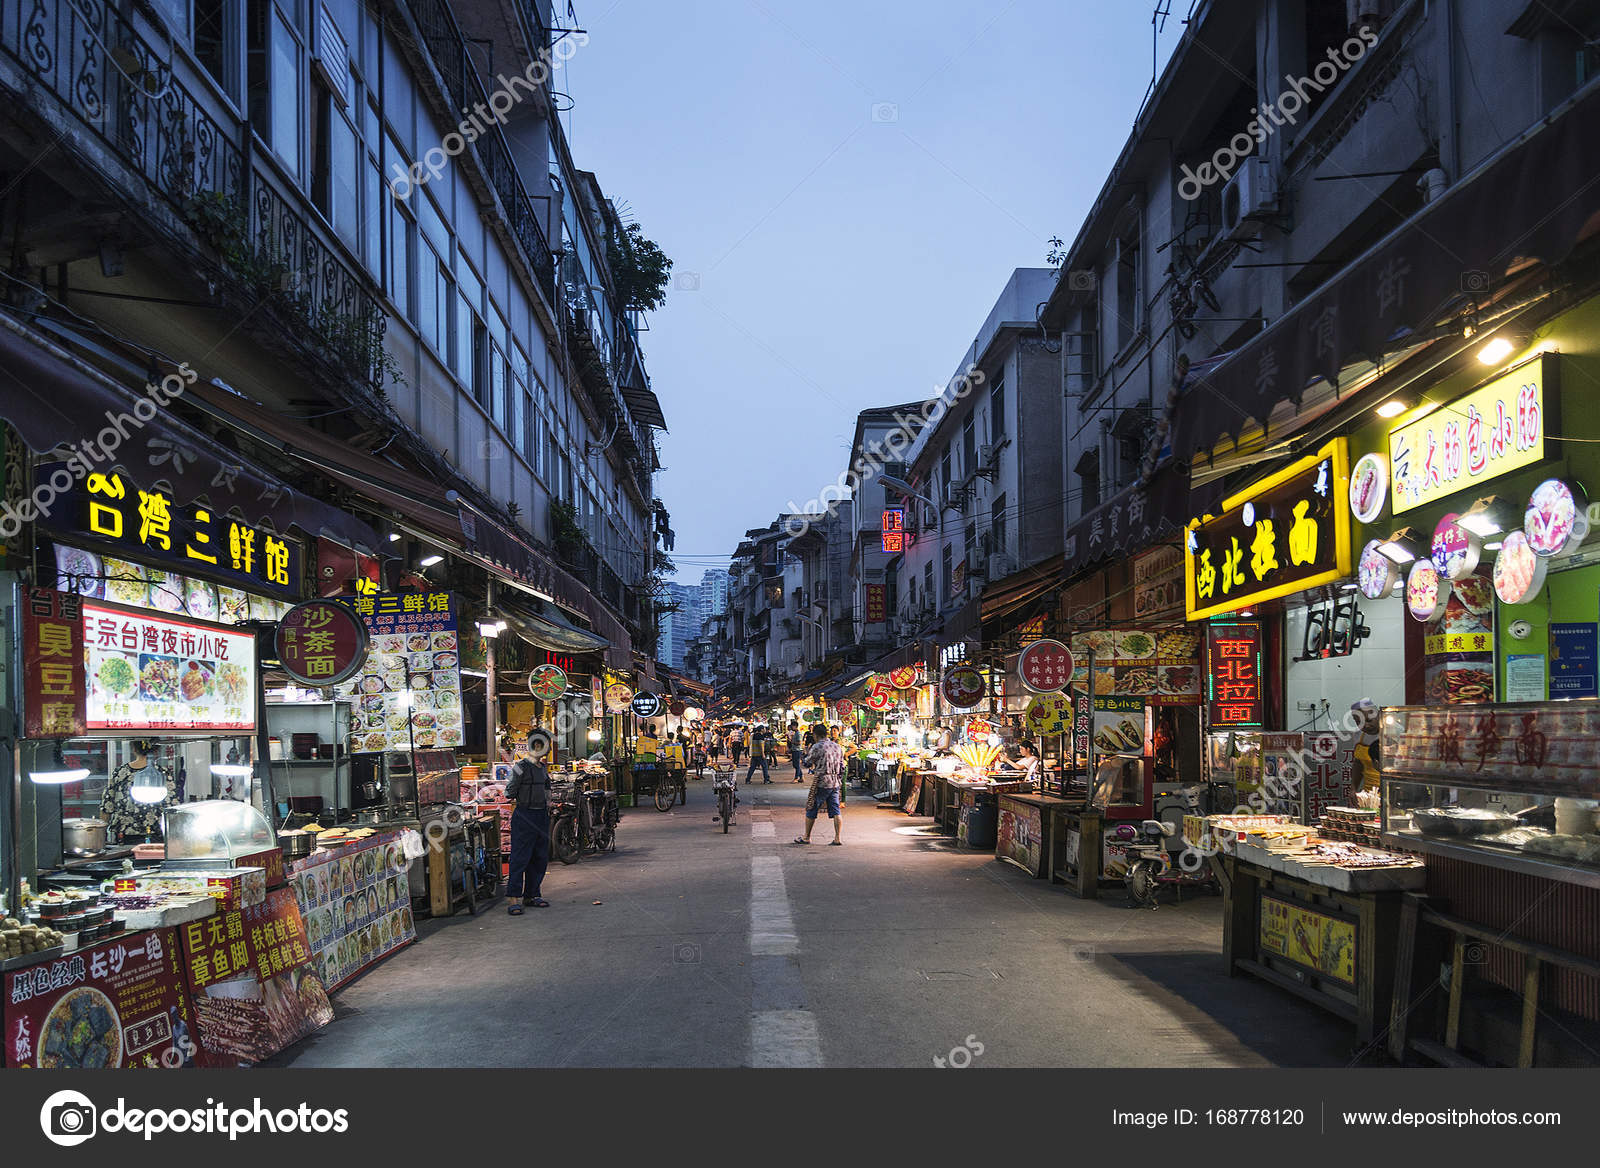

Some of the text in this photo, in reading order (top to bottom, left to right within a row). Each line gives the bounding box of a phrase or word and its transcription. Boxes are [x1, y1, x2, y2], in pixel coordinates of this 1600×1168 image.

[1423, 383, 1541, 491] 大肠包小肠
[86, 473, 290, 586] 台湾三鲜馆
[1088, 493, 1147, 547] 美食街
[30, 587, 81, 622] 台湾
[341, 592, 450, 616] 湾三鲜馆
[284, 627, 298, 660] 厦门
[303, 607, 336, 677] 沙茶面
[38, 622, 76, 735] 臭豆腐
[1215, 639, 1255, 721] 西北拉面
[90, 933, 164, 979] 长沙一绝
[187, 911, 243, 954] 巨无霸
[252, 914, 299, 951] 铁板鱿鱼
[12, 955, 86, 1004] 黑色经典
[191, 940, 249, 987] 章鱼脚
[257, 940, 307, 978] 酱爆鱿鱼
[15, 1015, 32, 1062] 天然
